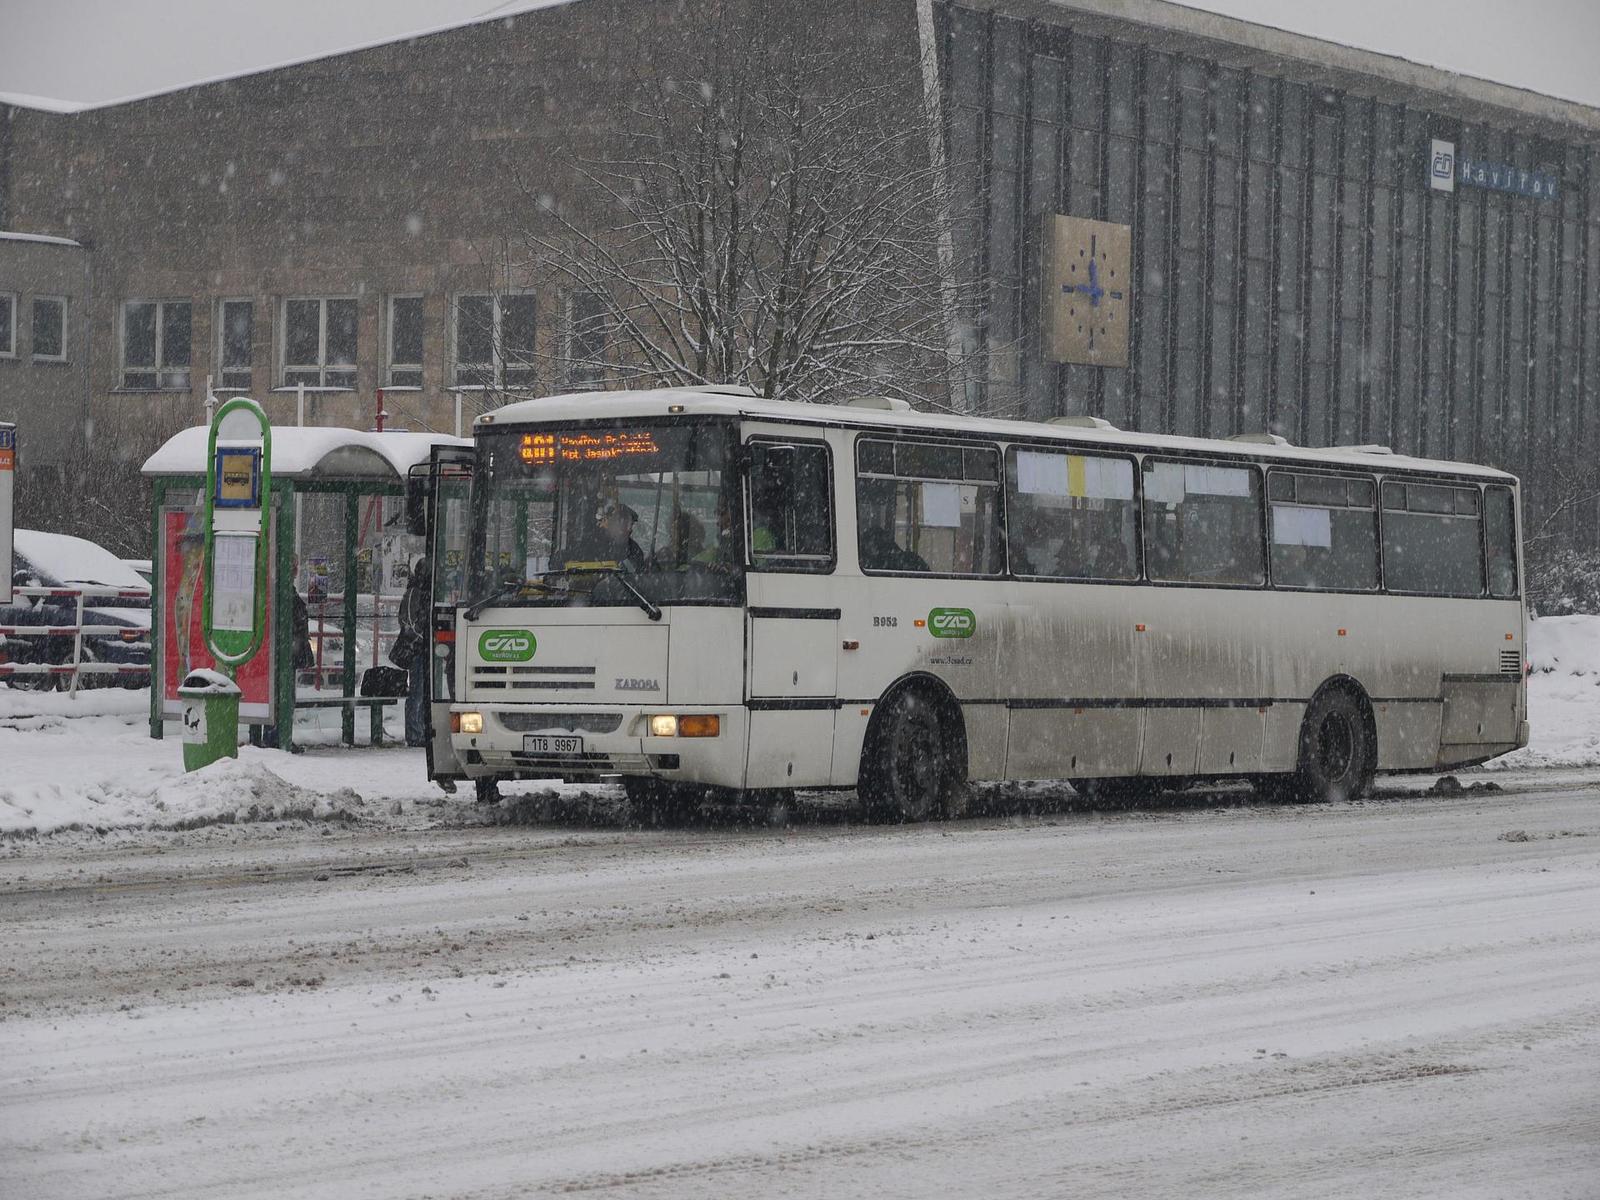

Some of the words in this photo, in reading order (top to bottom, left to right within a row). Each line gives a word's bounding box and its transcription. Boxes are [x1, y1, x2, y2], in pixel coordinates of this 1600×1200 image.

[615, 678, 660, 691] KAROSA
[532, 739, 549, 751] 1T8
[555, 739, 577, 751] 9967
